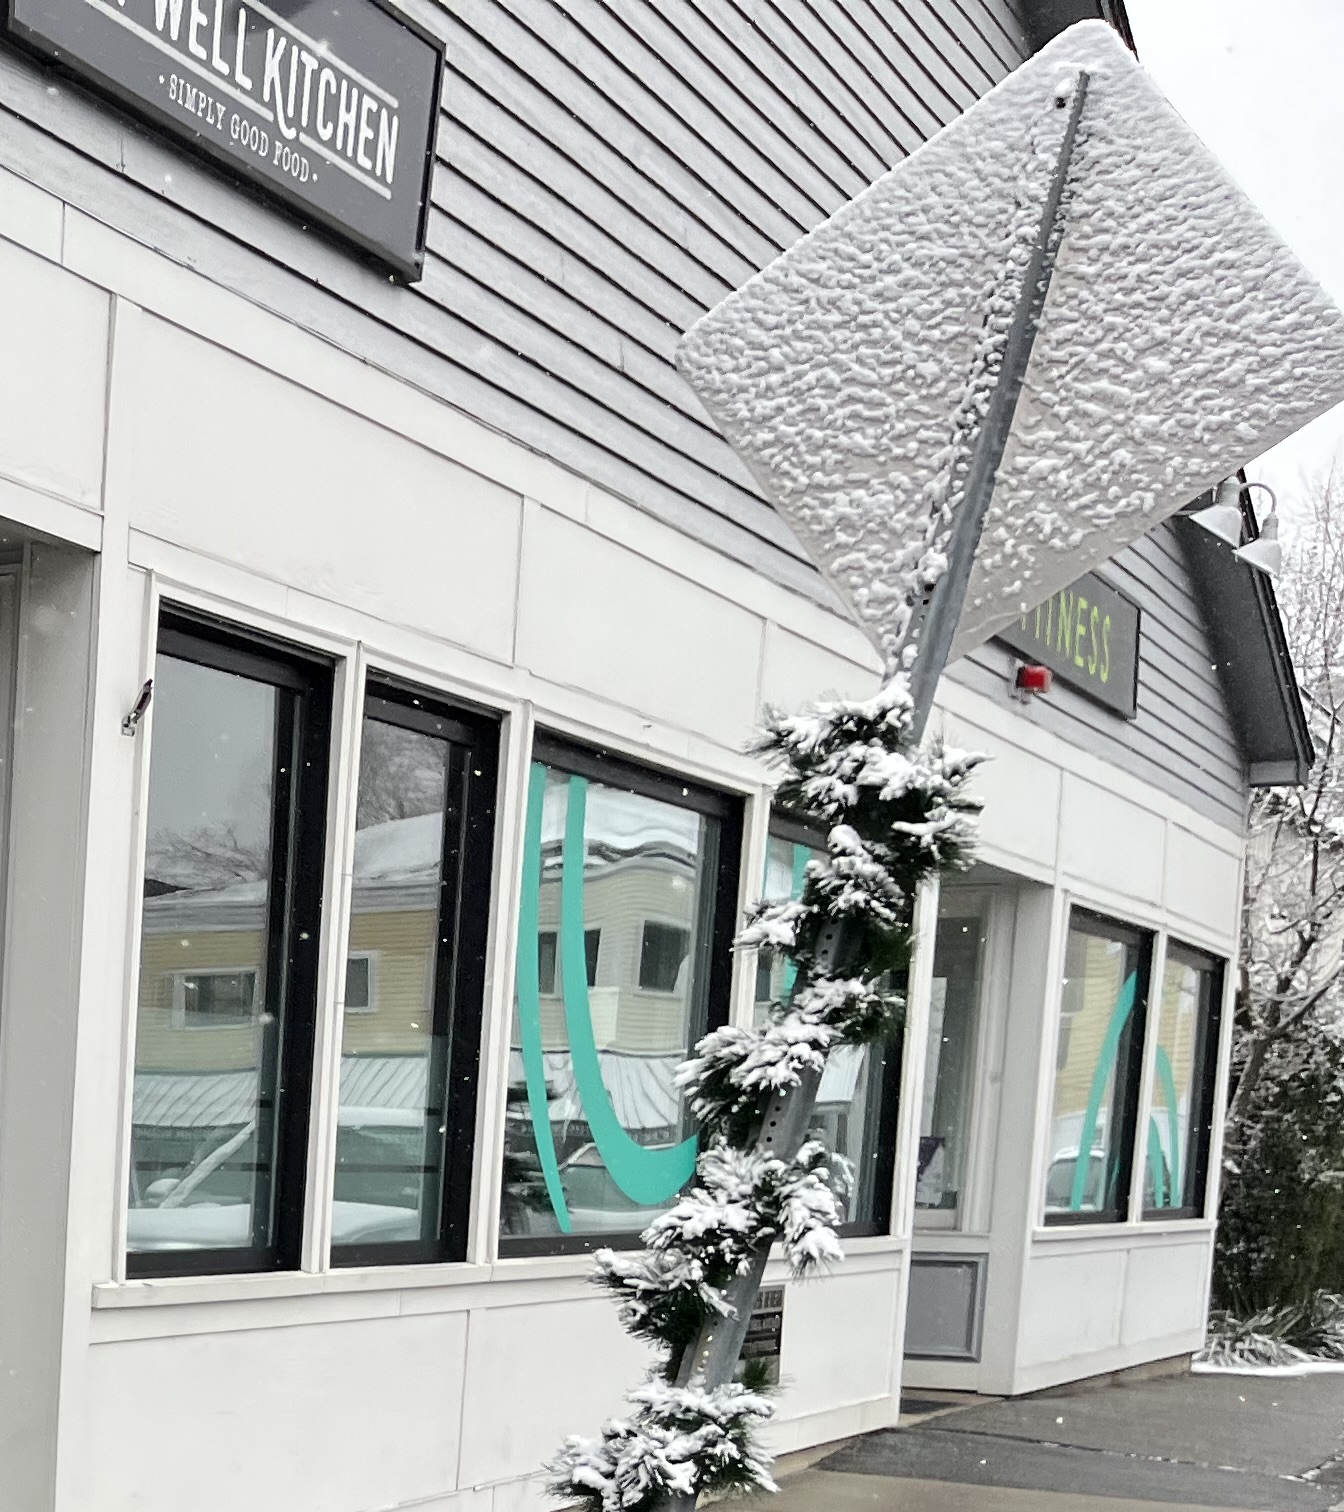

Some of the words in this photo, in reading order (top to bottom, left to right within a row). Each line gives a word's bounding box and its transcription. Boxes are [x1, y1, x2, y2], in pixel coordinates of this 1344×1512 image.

[168, 73, 226, 131] SIMPLY
[230, 113, 270, 158] GOOD
[272, 139, 310, 184] FOOD
[262, 27, 399, 184] KITCHEN
